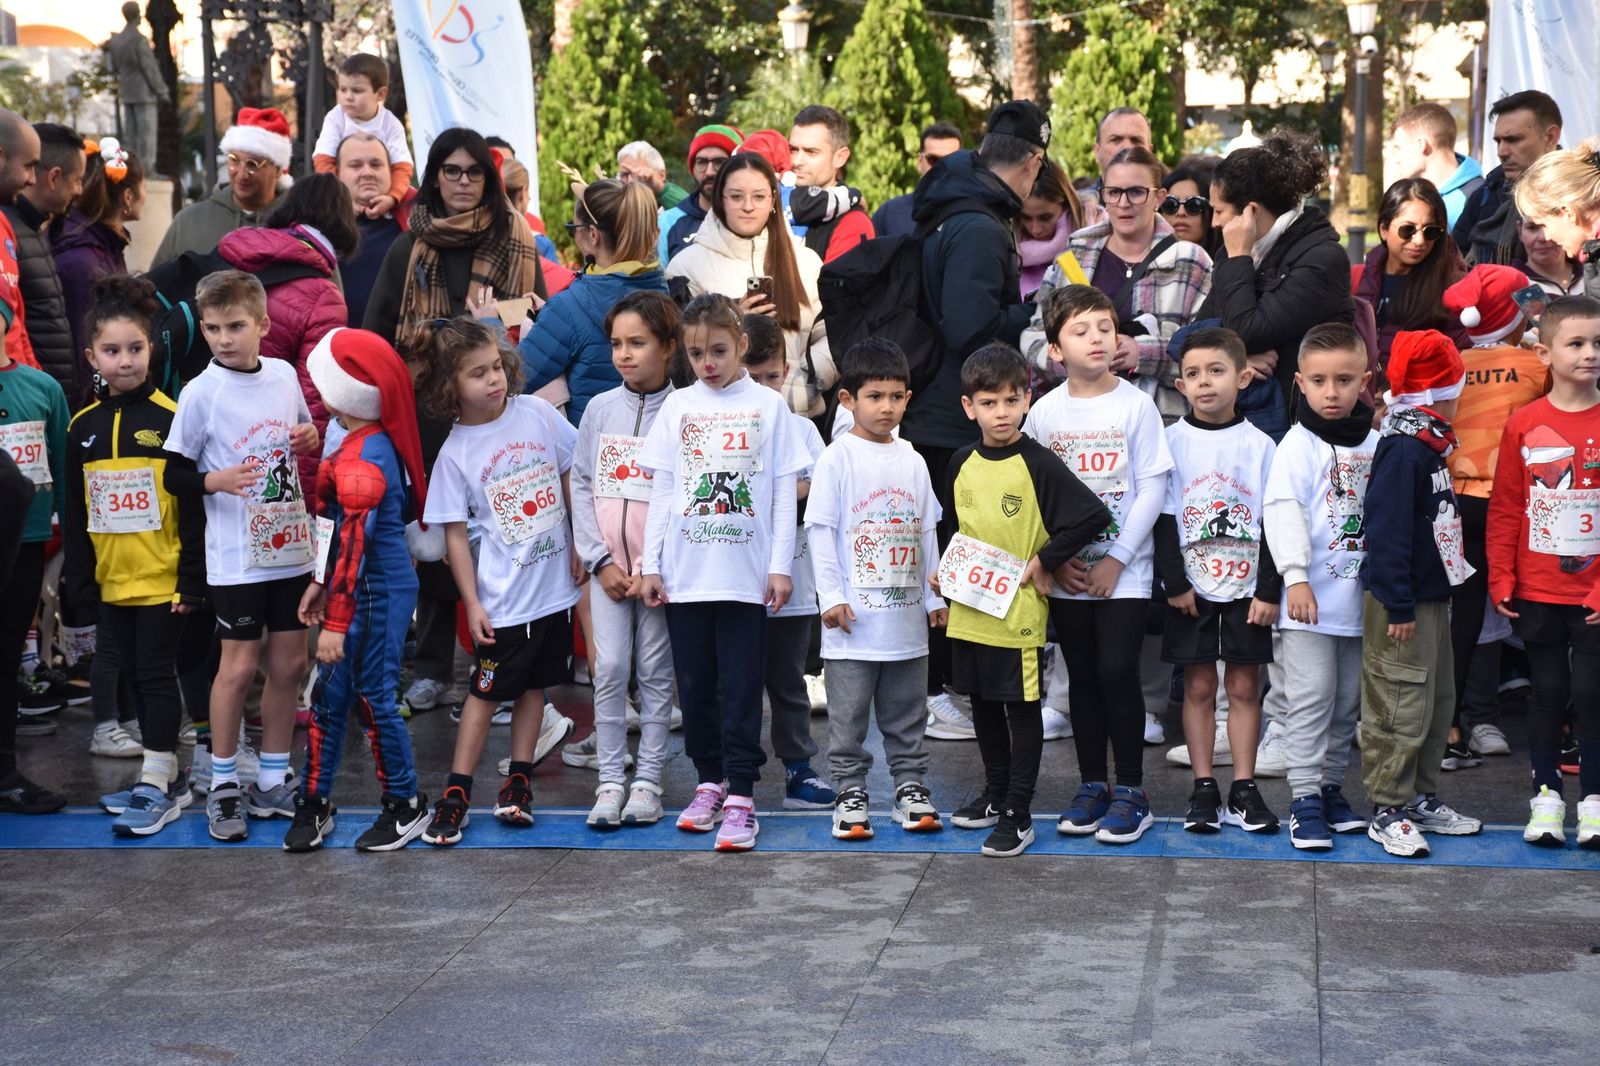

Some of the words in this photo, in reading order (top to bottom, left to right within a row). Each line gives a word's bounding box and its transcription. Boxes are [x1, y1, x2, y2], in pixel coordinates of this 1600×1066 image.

[1464, 368, 1519, 386] EUTA
[722, 431, 749, 450] 21
[11, 444, 42, 464] 297
[1077, 452, 1119, 472] 107
[108, 491, 150, 512] 348
[535, 486, 557, 509] 66
[693, 521, 743, 539] Martina
[1580, 513, 1594, 533] 3
[283, 523, 307, 544] 614
[889, 546, 917, 566] 171
[1211, 559, 1251, 579] 319
[968, 566, 1010, 595] 616
